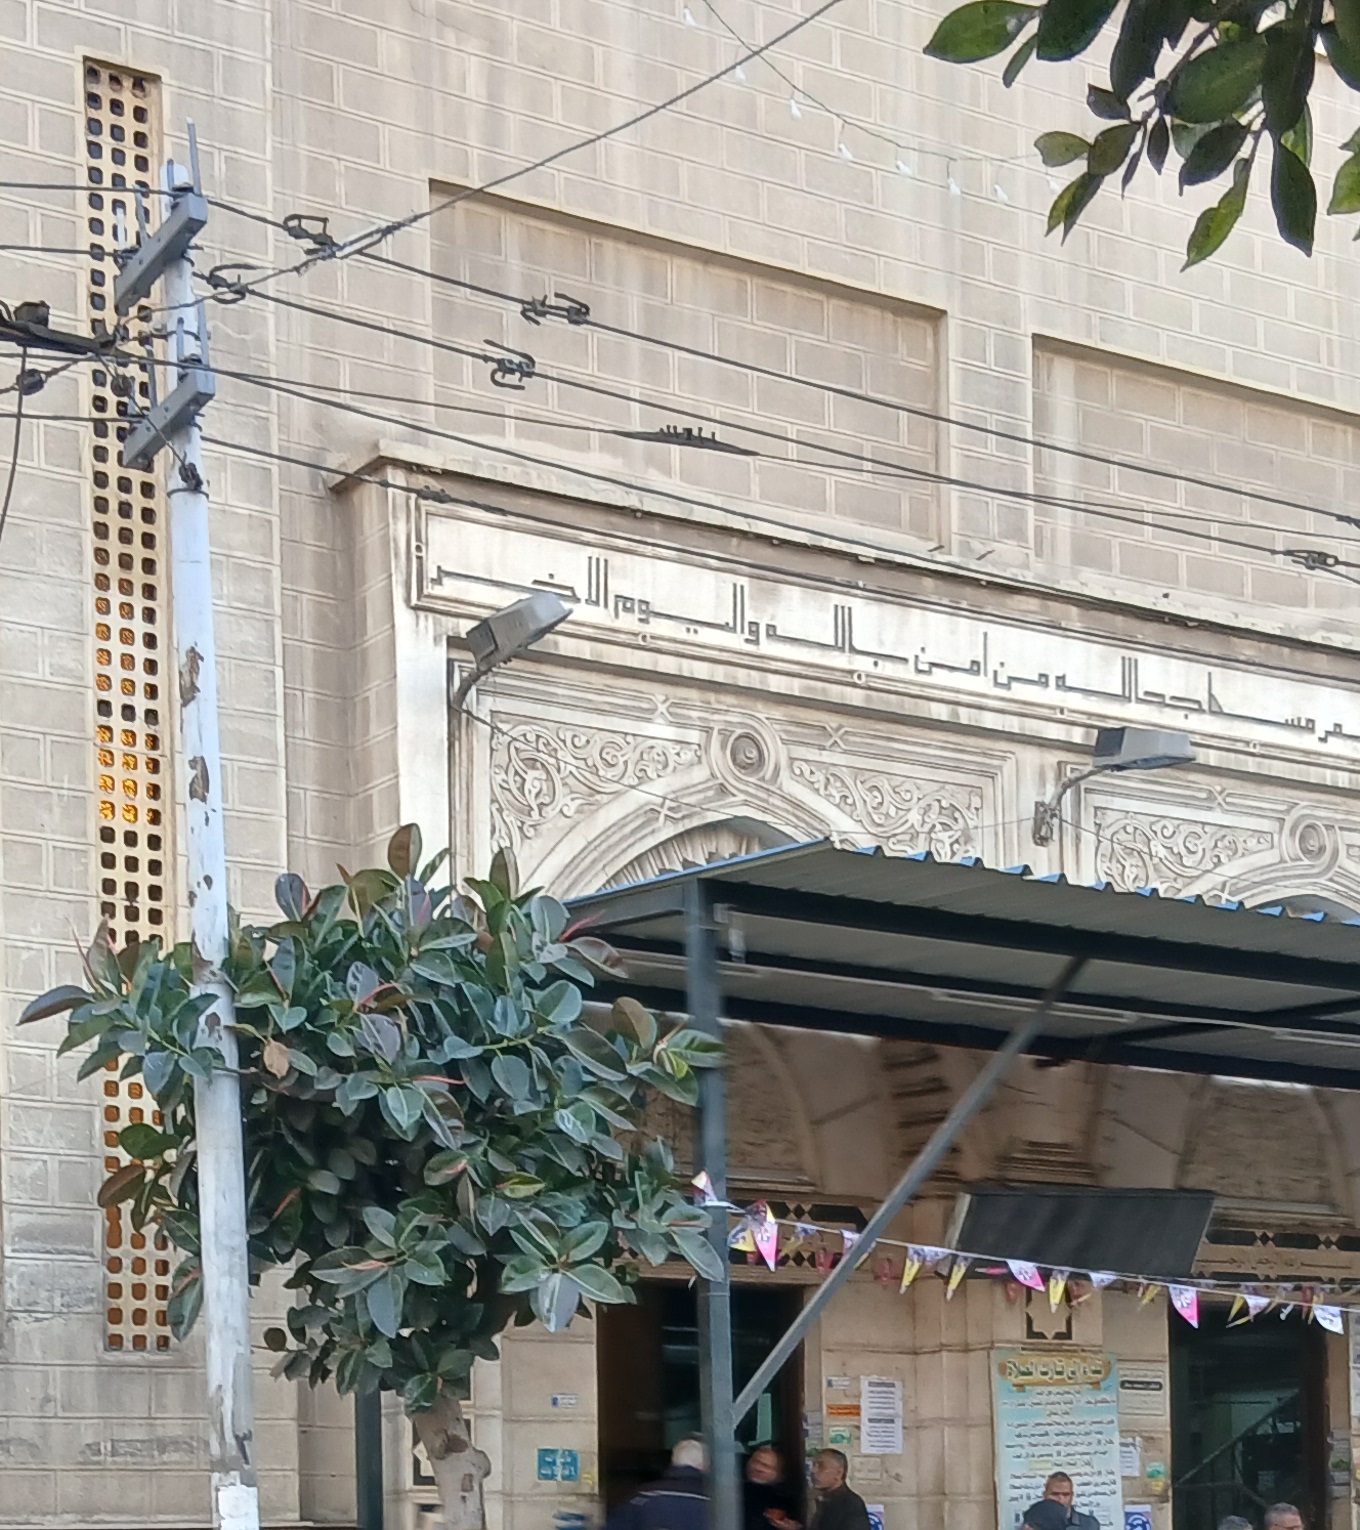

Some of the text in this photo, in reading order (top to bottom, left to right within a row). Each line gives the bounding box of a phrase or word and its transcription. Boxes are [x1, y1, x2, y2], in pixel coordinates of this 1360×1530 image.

[614, 582, 760, 647] واليوم
[993, 661, 1050, 690] من
[1055, 656, 1139, 703] الله
